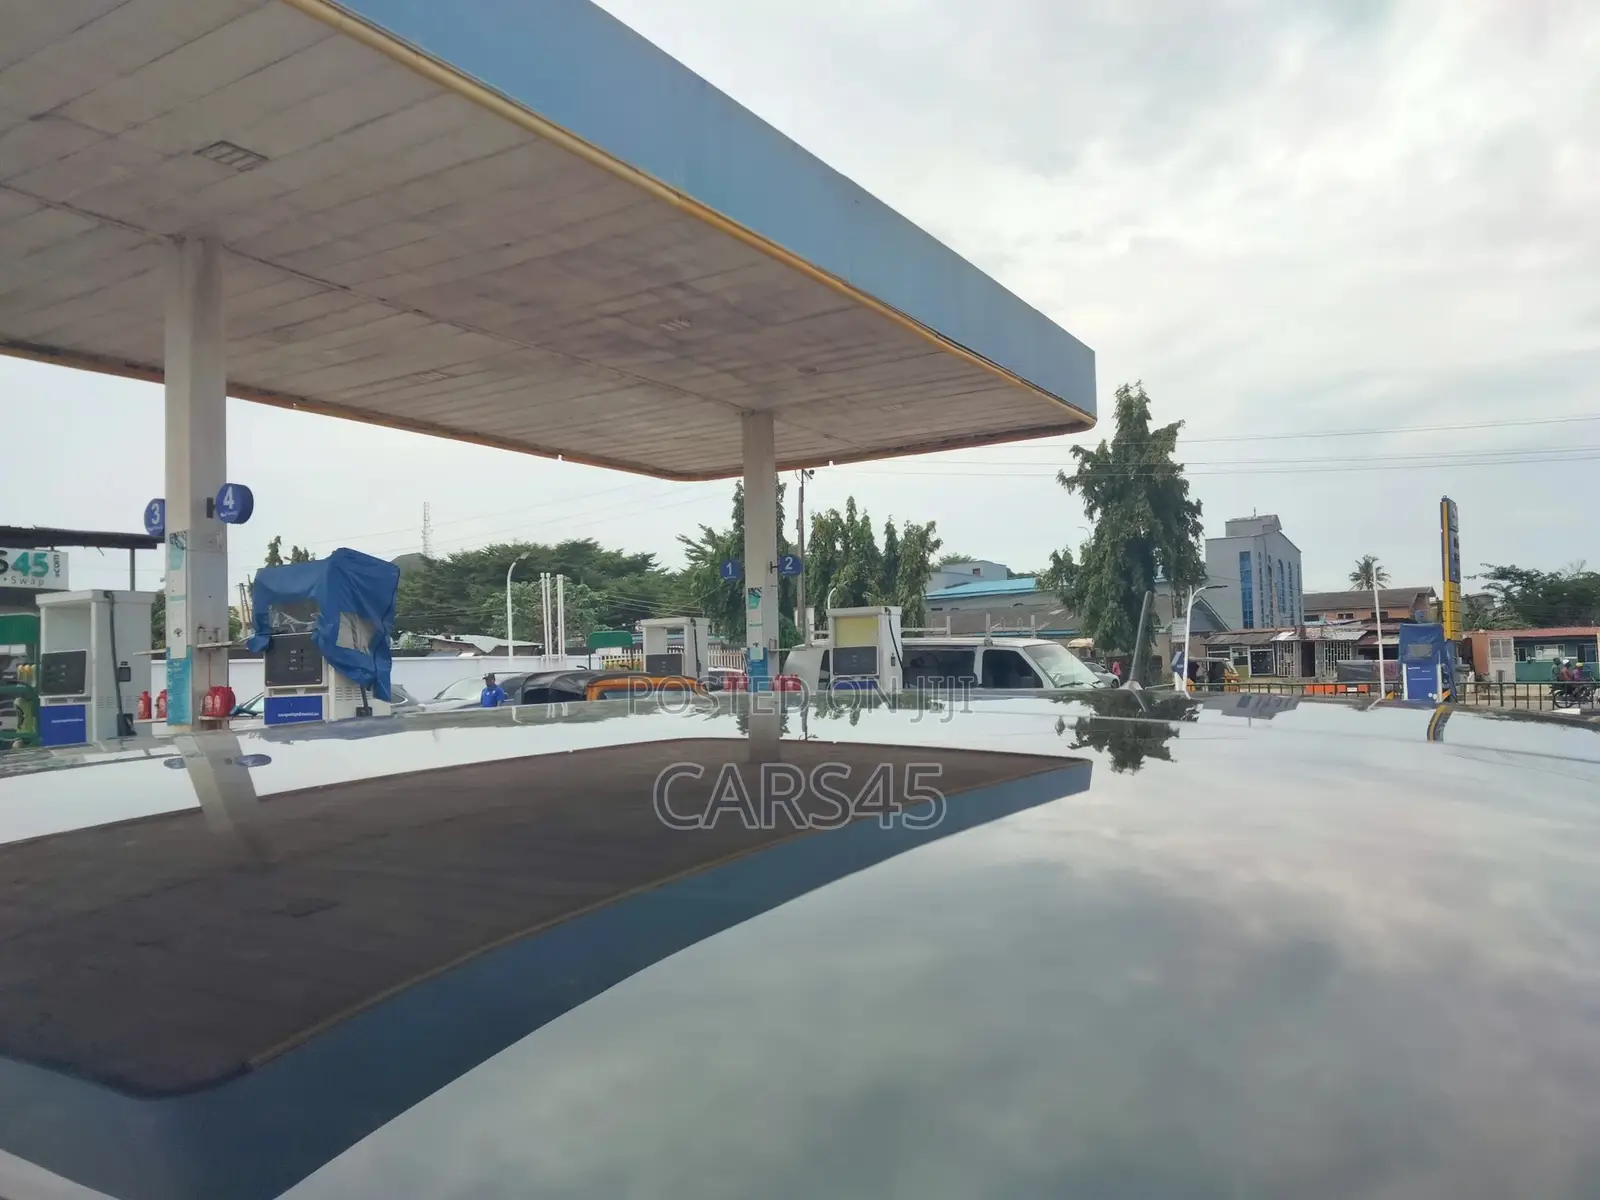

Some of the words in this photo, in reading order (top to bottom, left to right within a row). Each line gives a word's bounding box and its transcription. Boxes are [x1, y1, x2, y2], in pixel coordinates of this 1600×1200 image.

[223, 486, 235, 510] 4
[151, 503, 161, 525] 3
[726, 562, 732, 576] 1
[784, 556, 794, 570] 2
[11, 576, 45, 587] Swap
